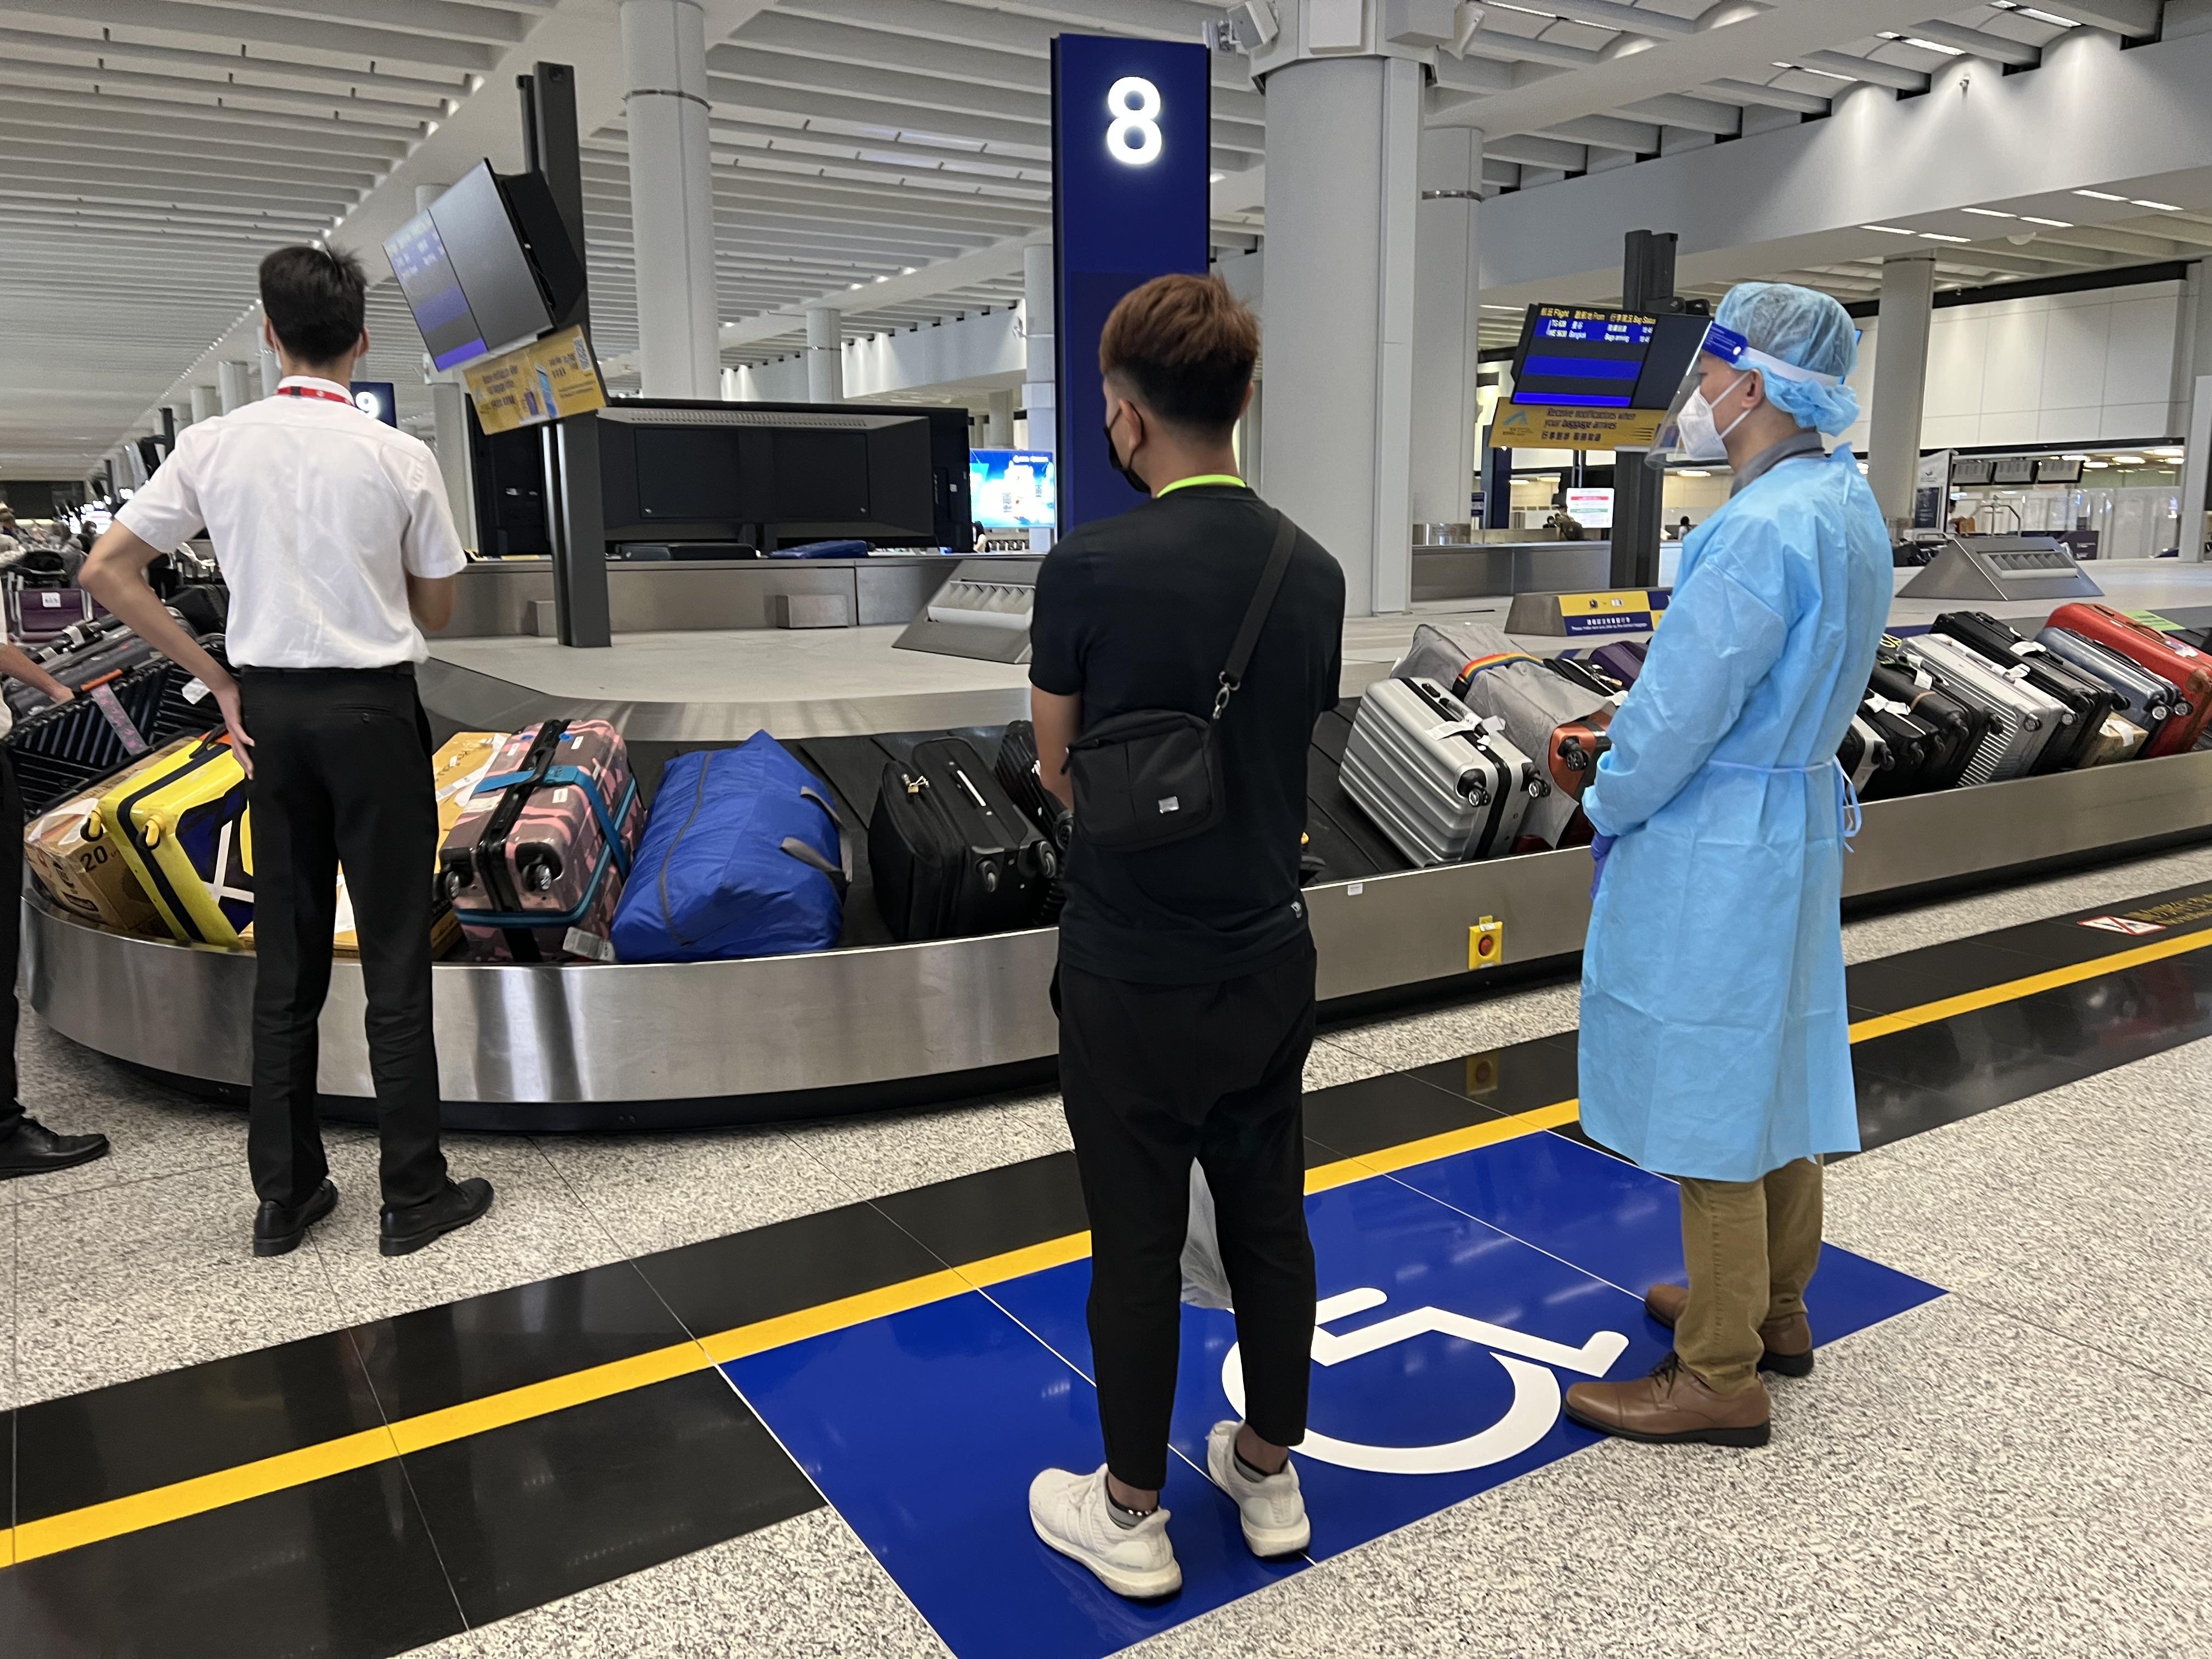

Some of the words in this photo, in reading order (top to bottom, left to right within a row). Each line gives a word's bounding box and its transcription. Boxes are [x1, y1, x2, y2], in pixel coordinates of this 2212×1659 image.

[1107, 76, 1162, 164] 8
[356, 391, 378, 419] 9
[80, 845, 108, 872] 20
